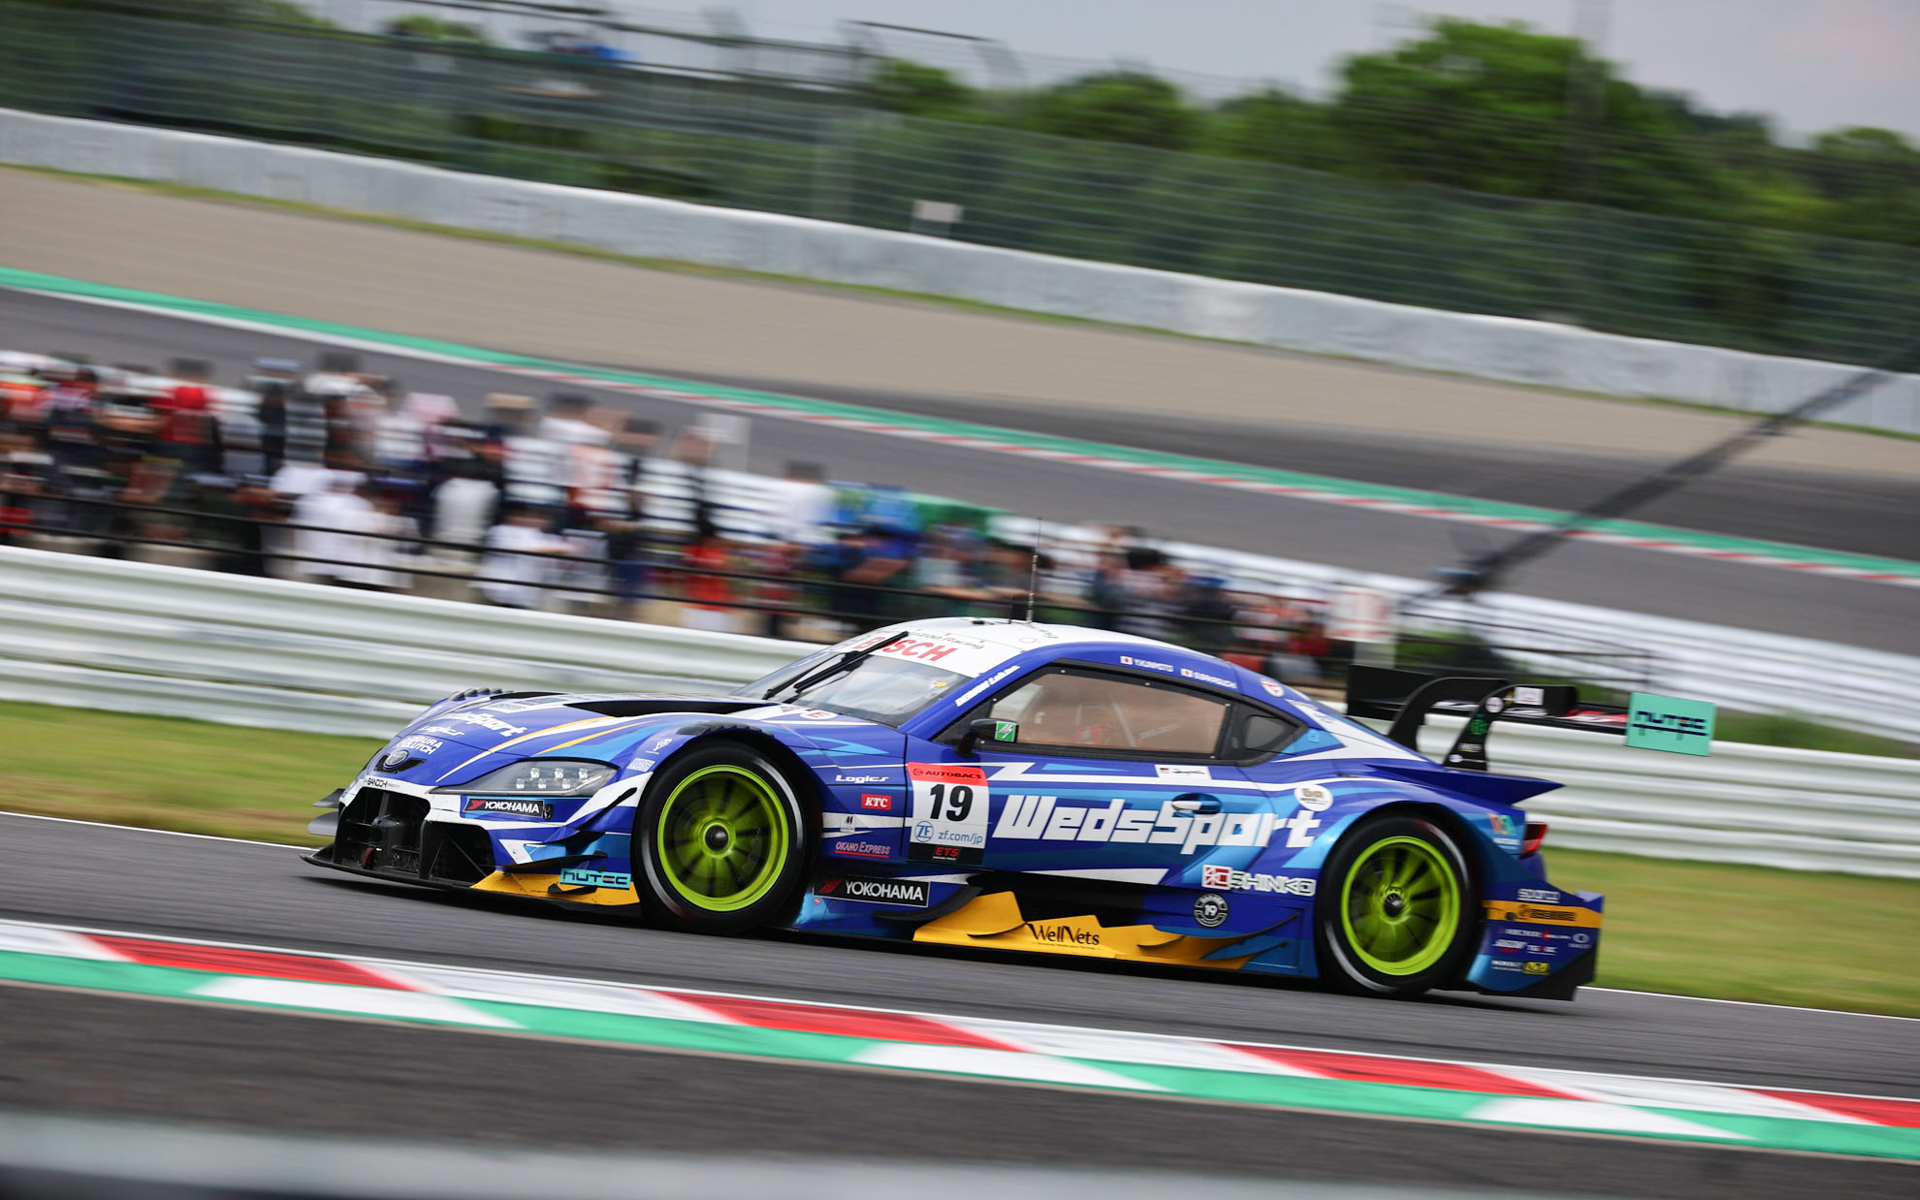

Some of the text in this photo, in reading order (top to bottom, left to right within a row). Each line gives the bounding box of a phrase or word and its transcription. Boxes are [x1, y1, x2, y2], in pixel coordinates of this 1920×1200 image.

[852, 636, 958, 661] BSCH
[835, 775, 889, 783] Logics
[925, 770, 982, 779] AUTOBACS
[484, 800, 540, 814] YOKOHAMA
[864, 797, 888, 808] KTC
[930, 784, 974, 822] 19
[991, 794, 1322, 855] WedsSport
[938, 831, 983, 845] zf.com/jp
[859, 841, 891, 855] EXPRESS
[935, 847, 960, 857] ETS
[1231, 870, 1317, 897] SHINKO
[845, 880, 923, 902] YOKOHAMA
[1204, 905, 1218, 917] 19
